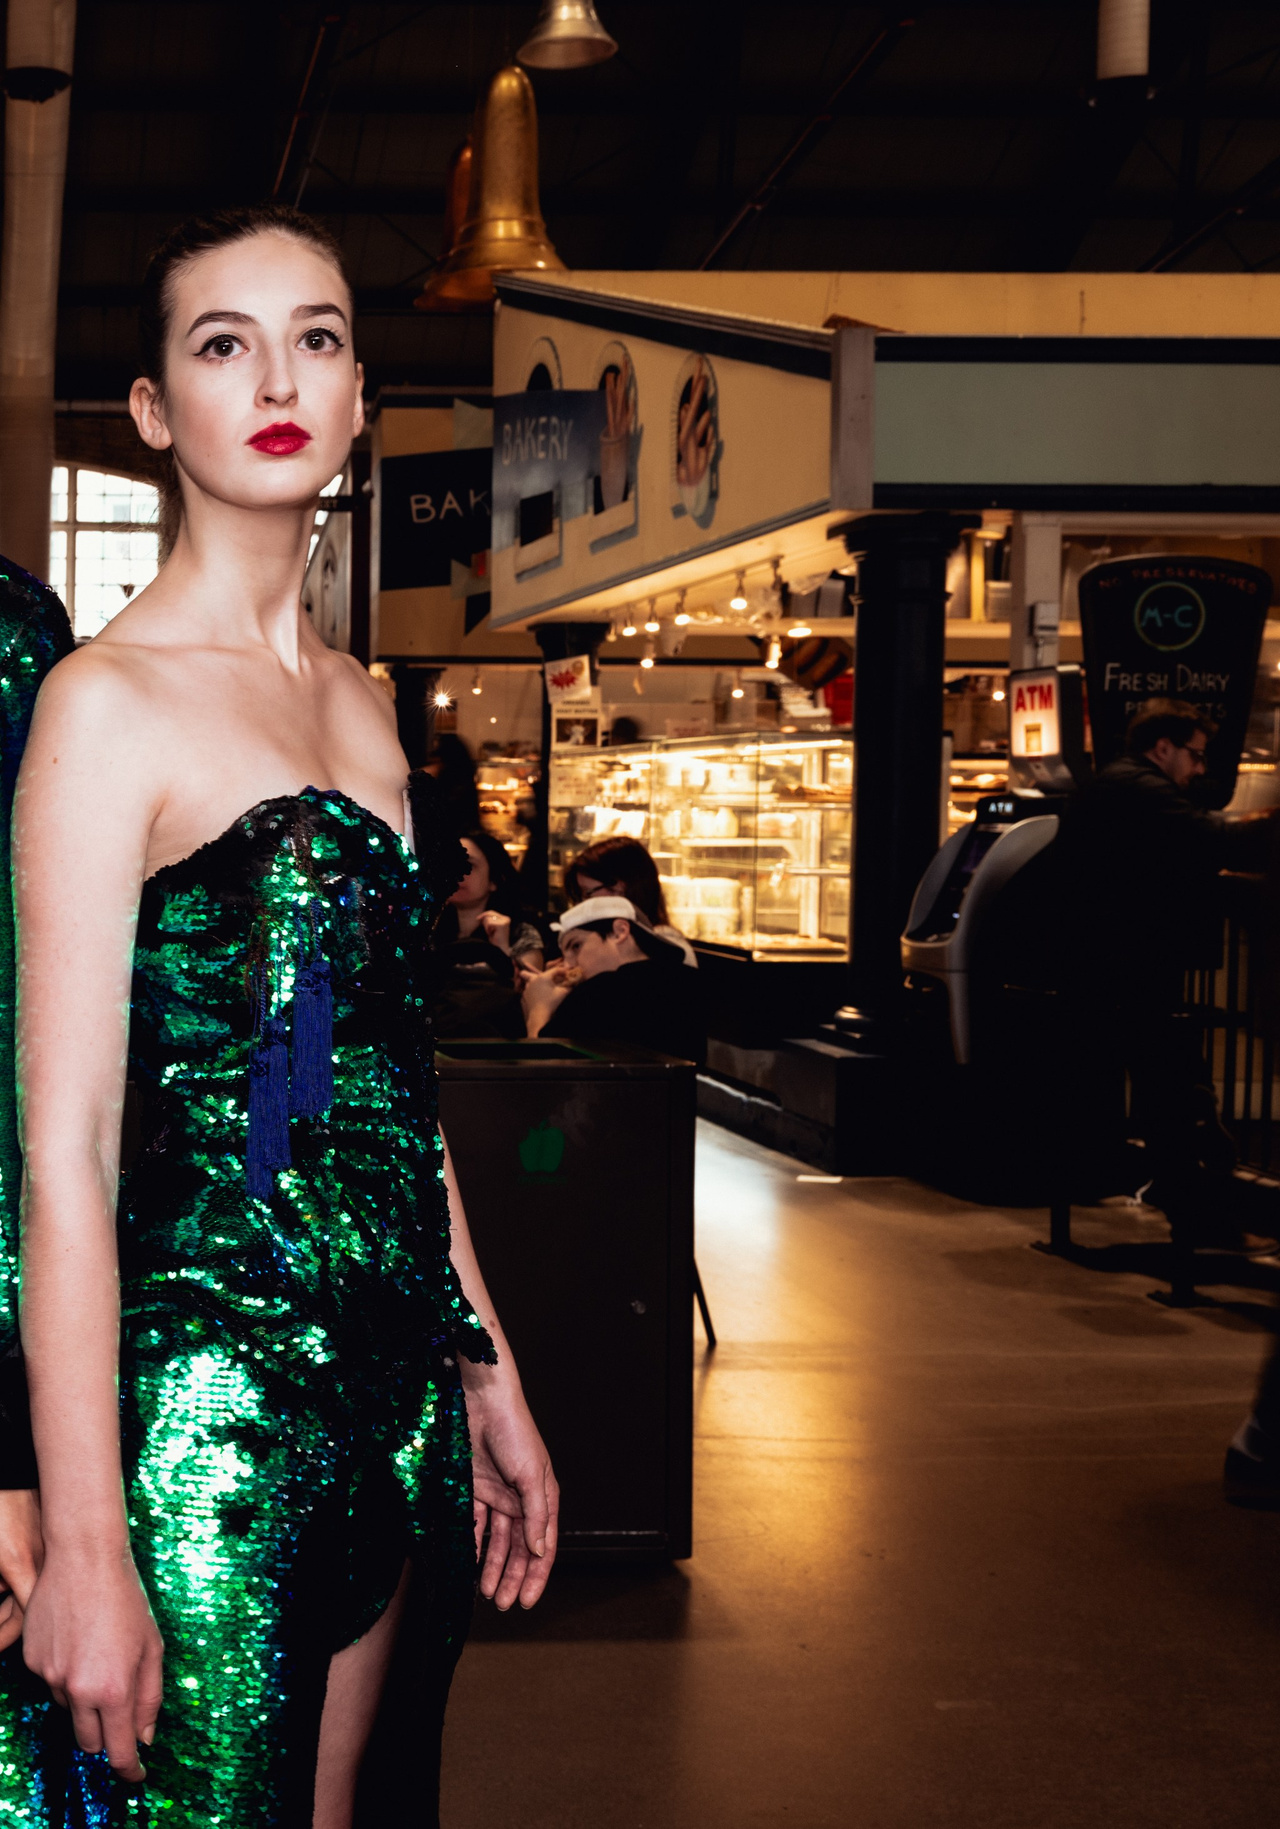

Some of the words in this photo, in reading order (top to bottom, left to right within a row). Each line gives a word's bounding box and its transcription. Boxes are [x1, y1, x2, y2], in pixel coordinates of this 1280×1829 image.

[501, 415, 574, 466] BAKERY
[1141, 604, 1194, 629] M-C
[1103, 661, 1169, 692] FRESH
[1175, 662, 1231, 693] DAIRY
[1014, 684, 1054, 713] ATM
[987, 801, 1015, 814] ATM
